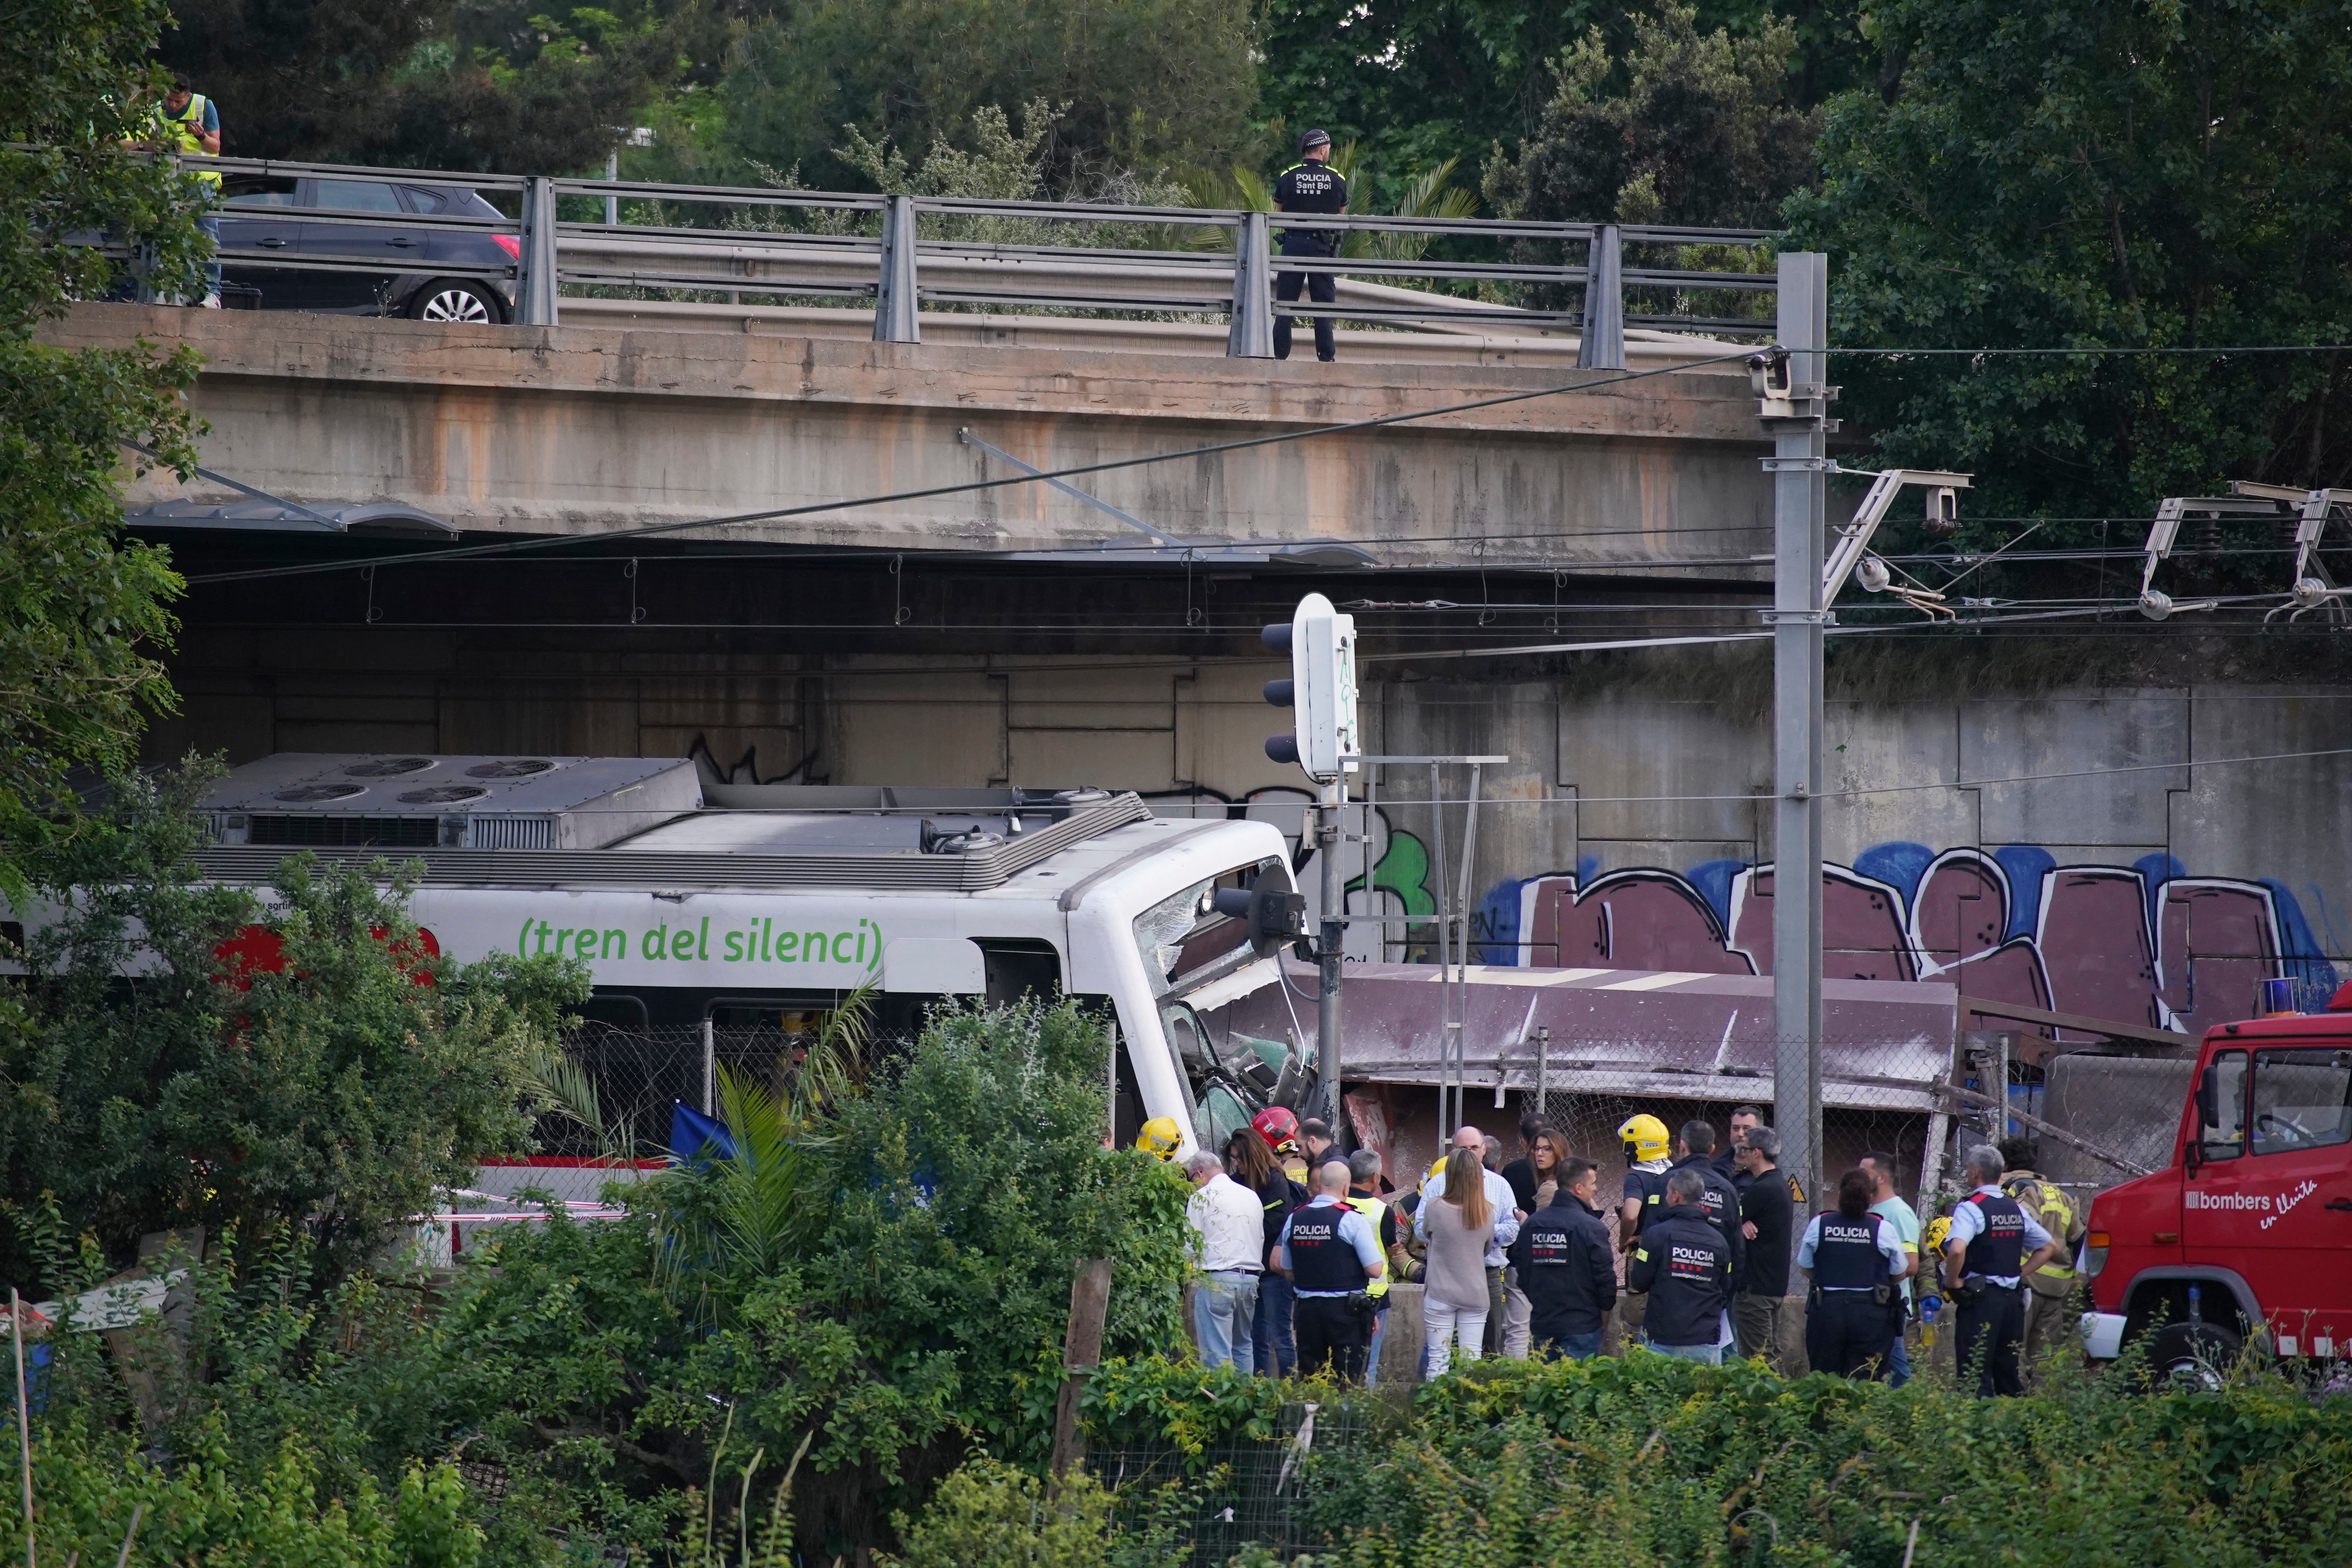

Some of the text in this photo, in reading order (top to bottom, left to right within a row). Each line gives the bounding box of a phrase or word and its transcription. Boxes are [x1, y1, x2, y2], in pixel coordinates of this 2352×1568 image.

[1296, 174, 1331, 182] POLICIA
[519, 916, 882, 973] (tren del silenci)
[1701, 1191, 1723, 1203] ICIA
[2200, 1191, 2270, 1210] bombers
[1991, 1214, 2023, 1225] POLICIA
[1294, 1225, 1331, 1235] POLICIA
[1825, 1226, 1871, 1238] POLICIA
[1532, 1233, 1567, 1243] POLICIA
[1672, 1247, 1714, 1262] POLICIA
